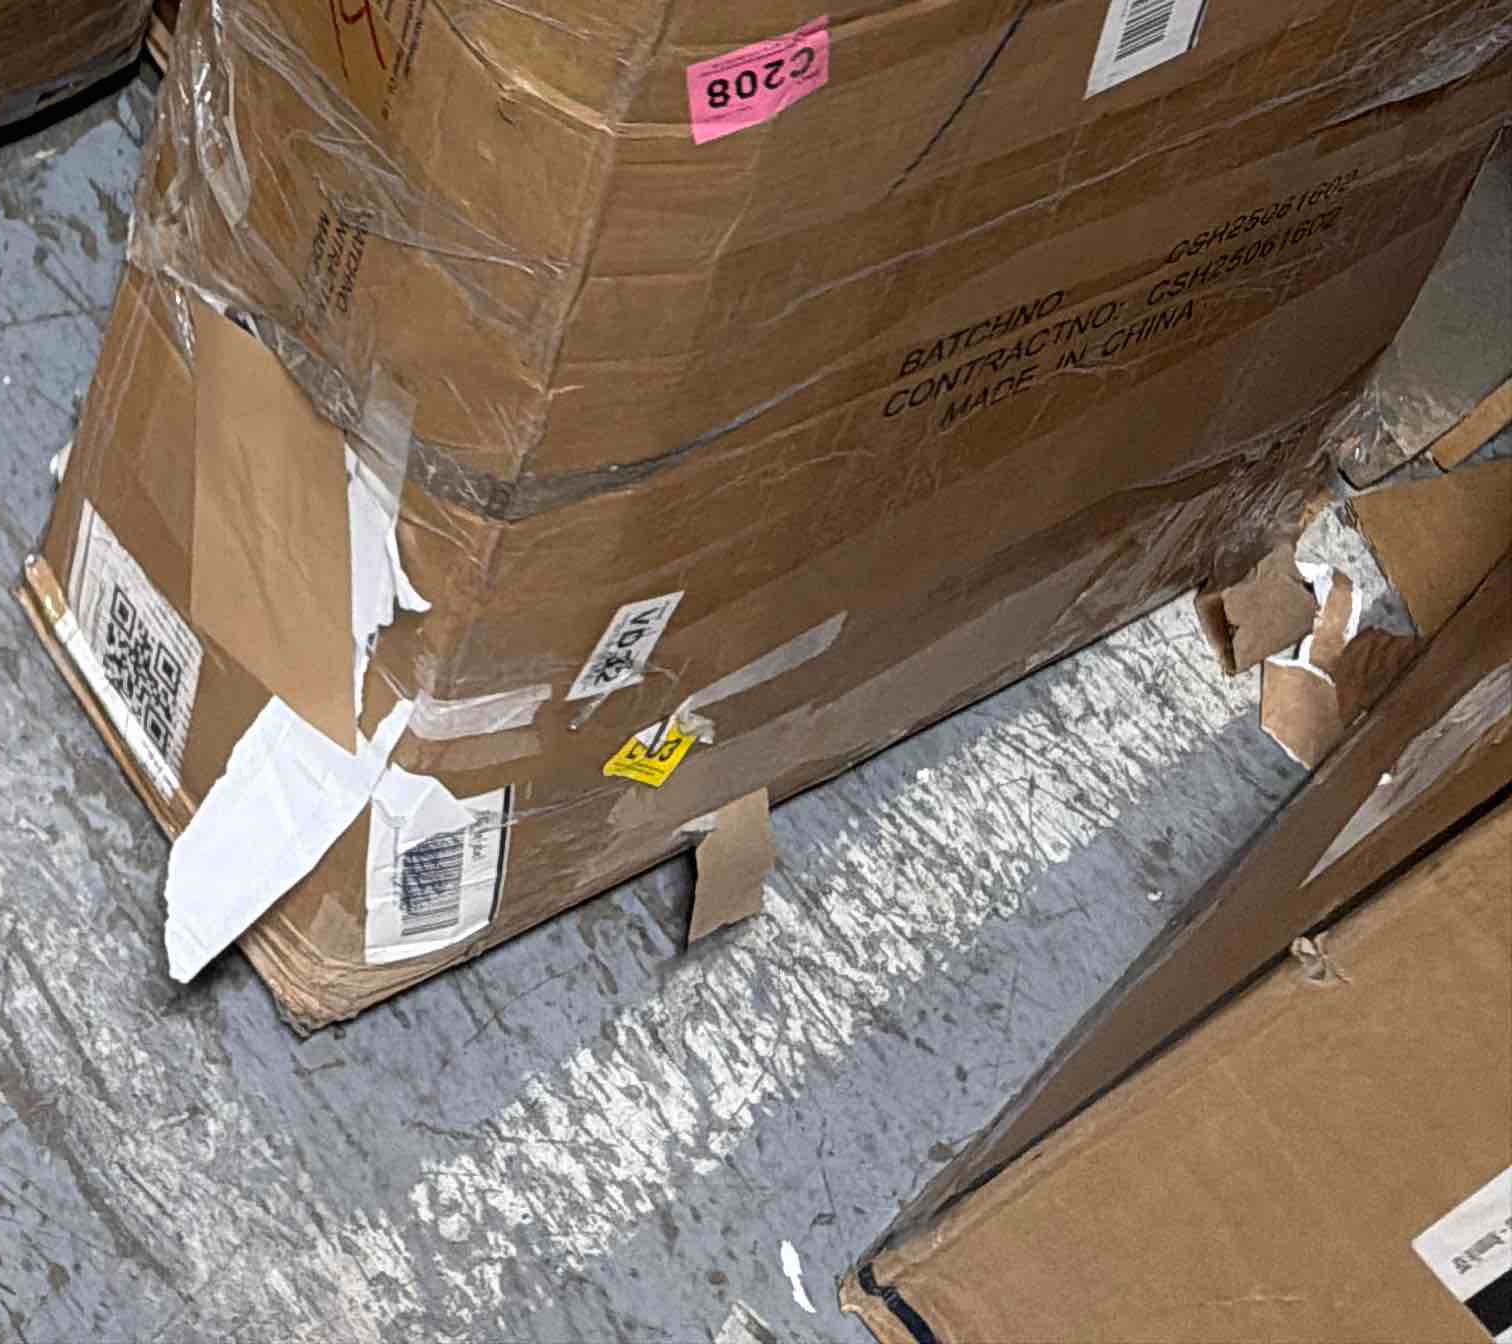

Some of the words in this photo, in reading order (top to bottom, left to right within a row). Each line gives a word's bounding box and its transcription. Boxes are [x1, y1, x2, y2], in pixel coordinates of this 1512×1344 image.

[706, 46, 815, 109] C208
[883, 300, 1129, 418] CONTRACTNO:
[940, 364, 1041, 430] MADE
[1055, 343, 1088, 369] IN
[1101, 300, 1196, 358] CHINA
